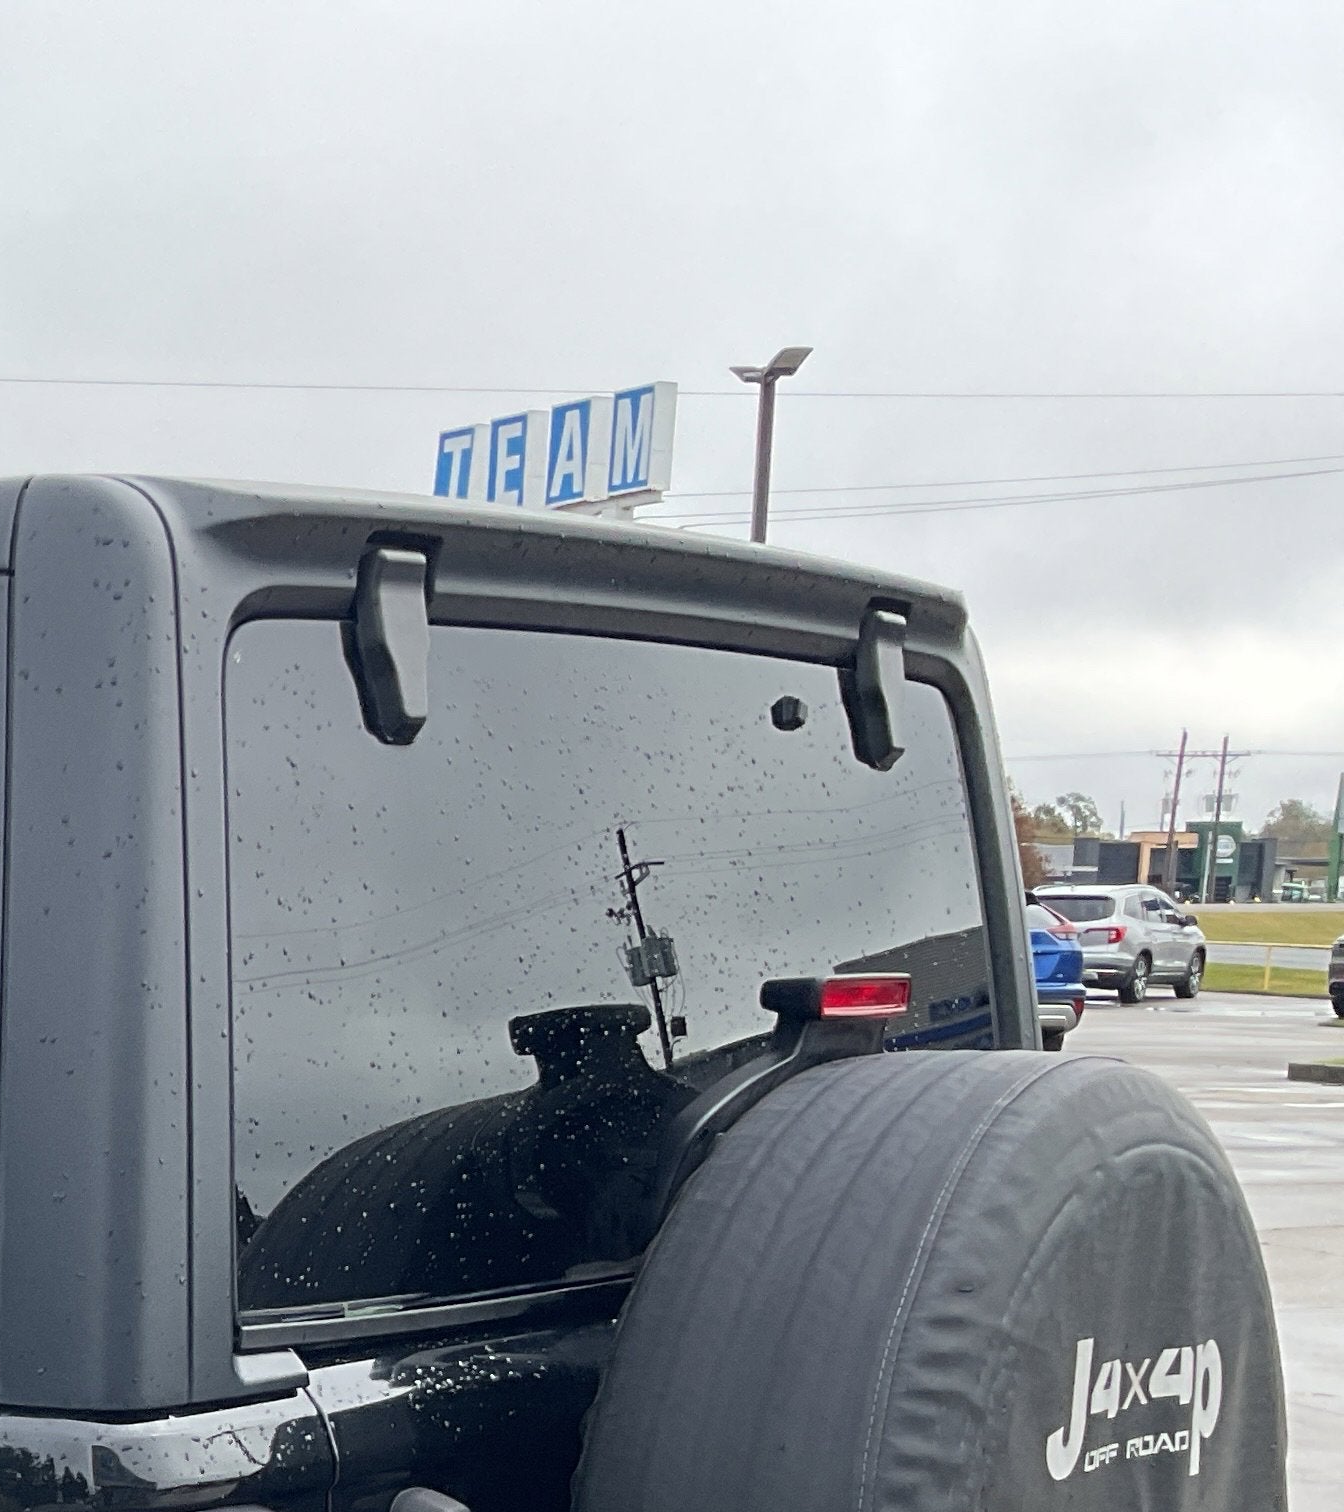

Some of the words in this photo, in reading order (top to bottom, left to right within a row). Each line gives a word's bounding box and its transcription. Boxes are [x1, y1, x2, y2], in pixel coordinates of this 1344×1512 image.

[443, 391, 654, 502] TEAM
[1083, 1443, 1119, 1472] OFF
[1125, 1430, 1189, 1459] ROAD
